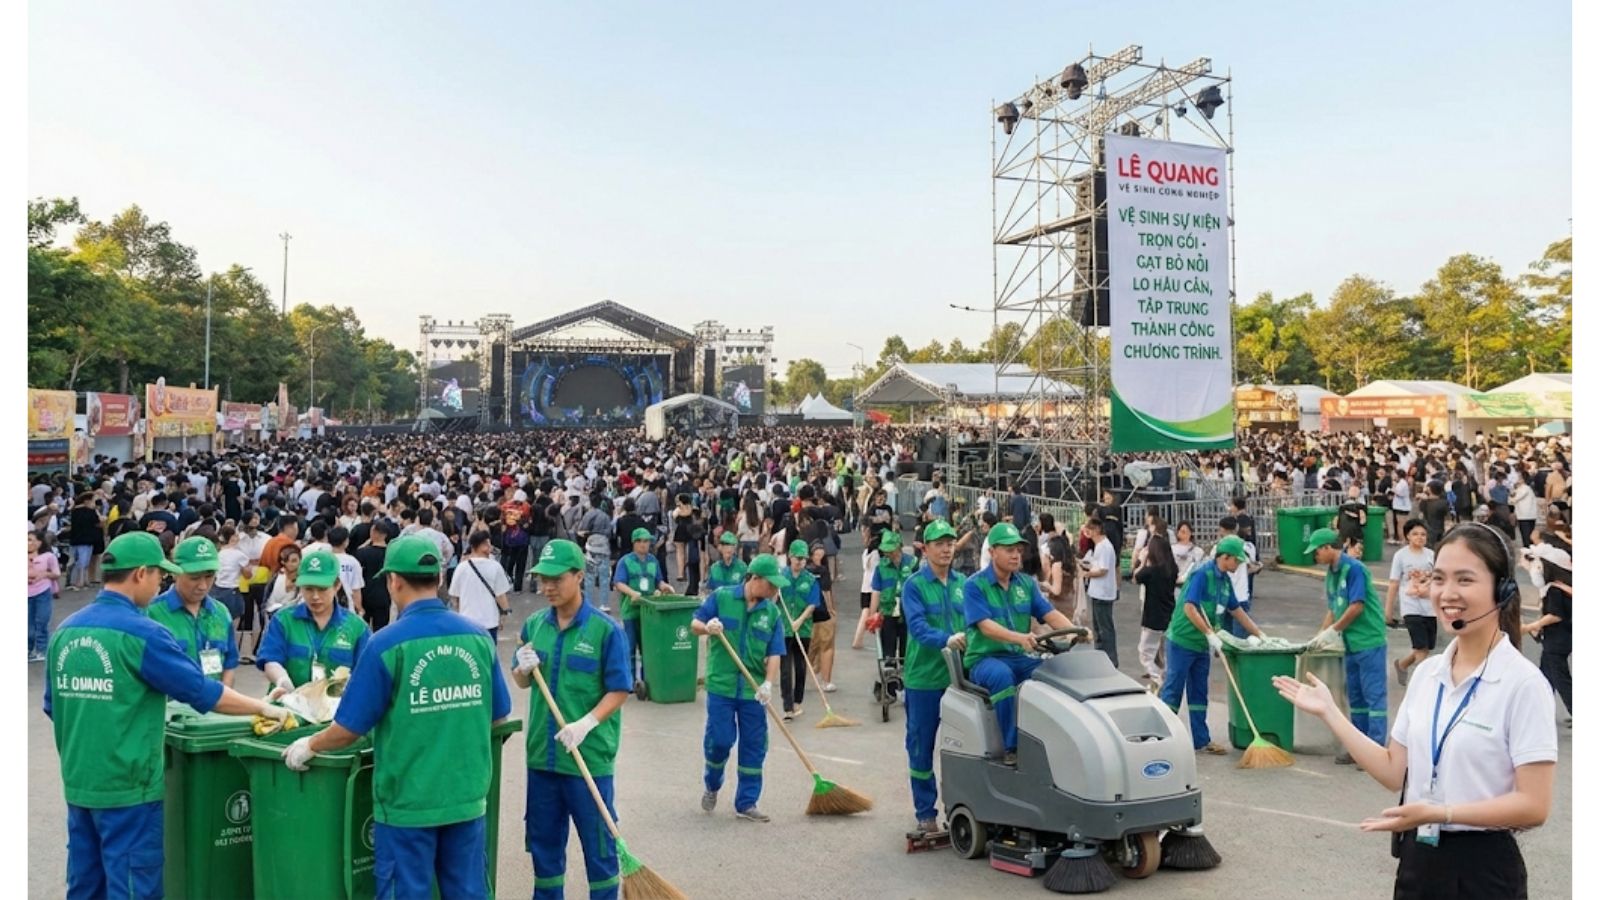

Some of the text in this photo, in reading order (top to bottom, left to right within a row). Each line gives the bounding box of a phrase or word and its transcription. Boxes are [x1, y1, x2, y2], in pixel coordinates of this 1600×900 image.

[1118, 153, 1218, 186] LÊ QUANG
[1118, 206, 1220, 232] VỆ SINH SỰ KIỆN
[1138, 232, 1173, 251] TRỌN
[1177, 232, 1198, 249] GÓI
[1136, 254, 1162, 272] GẠT
[1132, 277, 1150, 291] LO
[1166, 300, 1209, 316] TRUNG
[1180, 320, 1215, 337] CÔNG
[1124, 343, 1180, 359] CHƯƠNG
